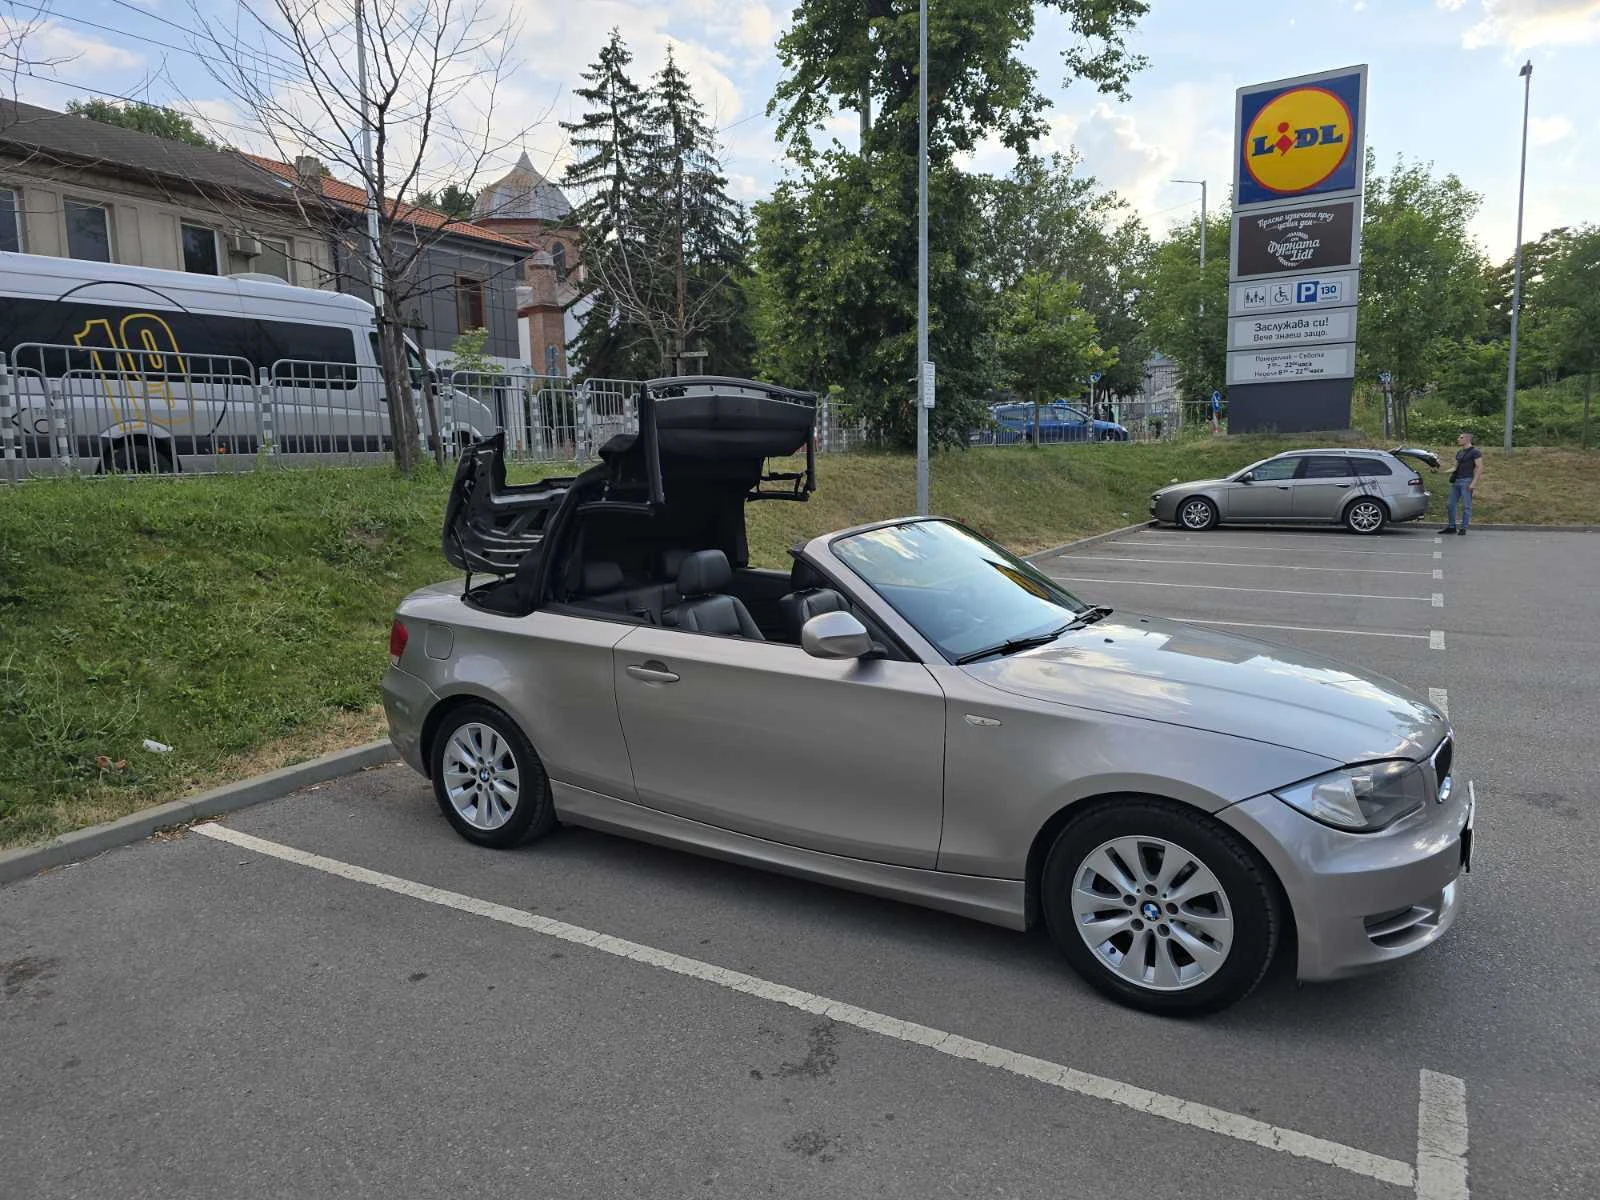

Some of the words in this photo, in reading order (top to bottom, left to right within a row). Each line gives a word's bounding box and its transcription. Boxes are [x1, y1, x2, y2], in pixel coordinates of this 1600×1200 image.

[1320, 285, 1337, 295] 130
[1254, 319, 1310, 332] Заслужава
[1312, 317, 1329, 327] си!
